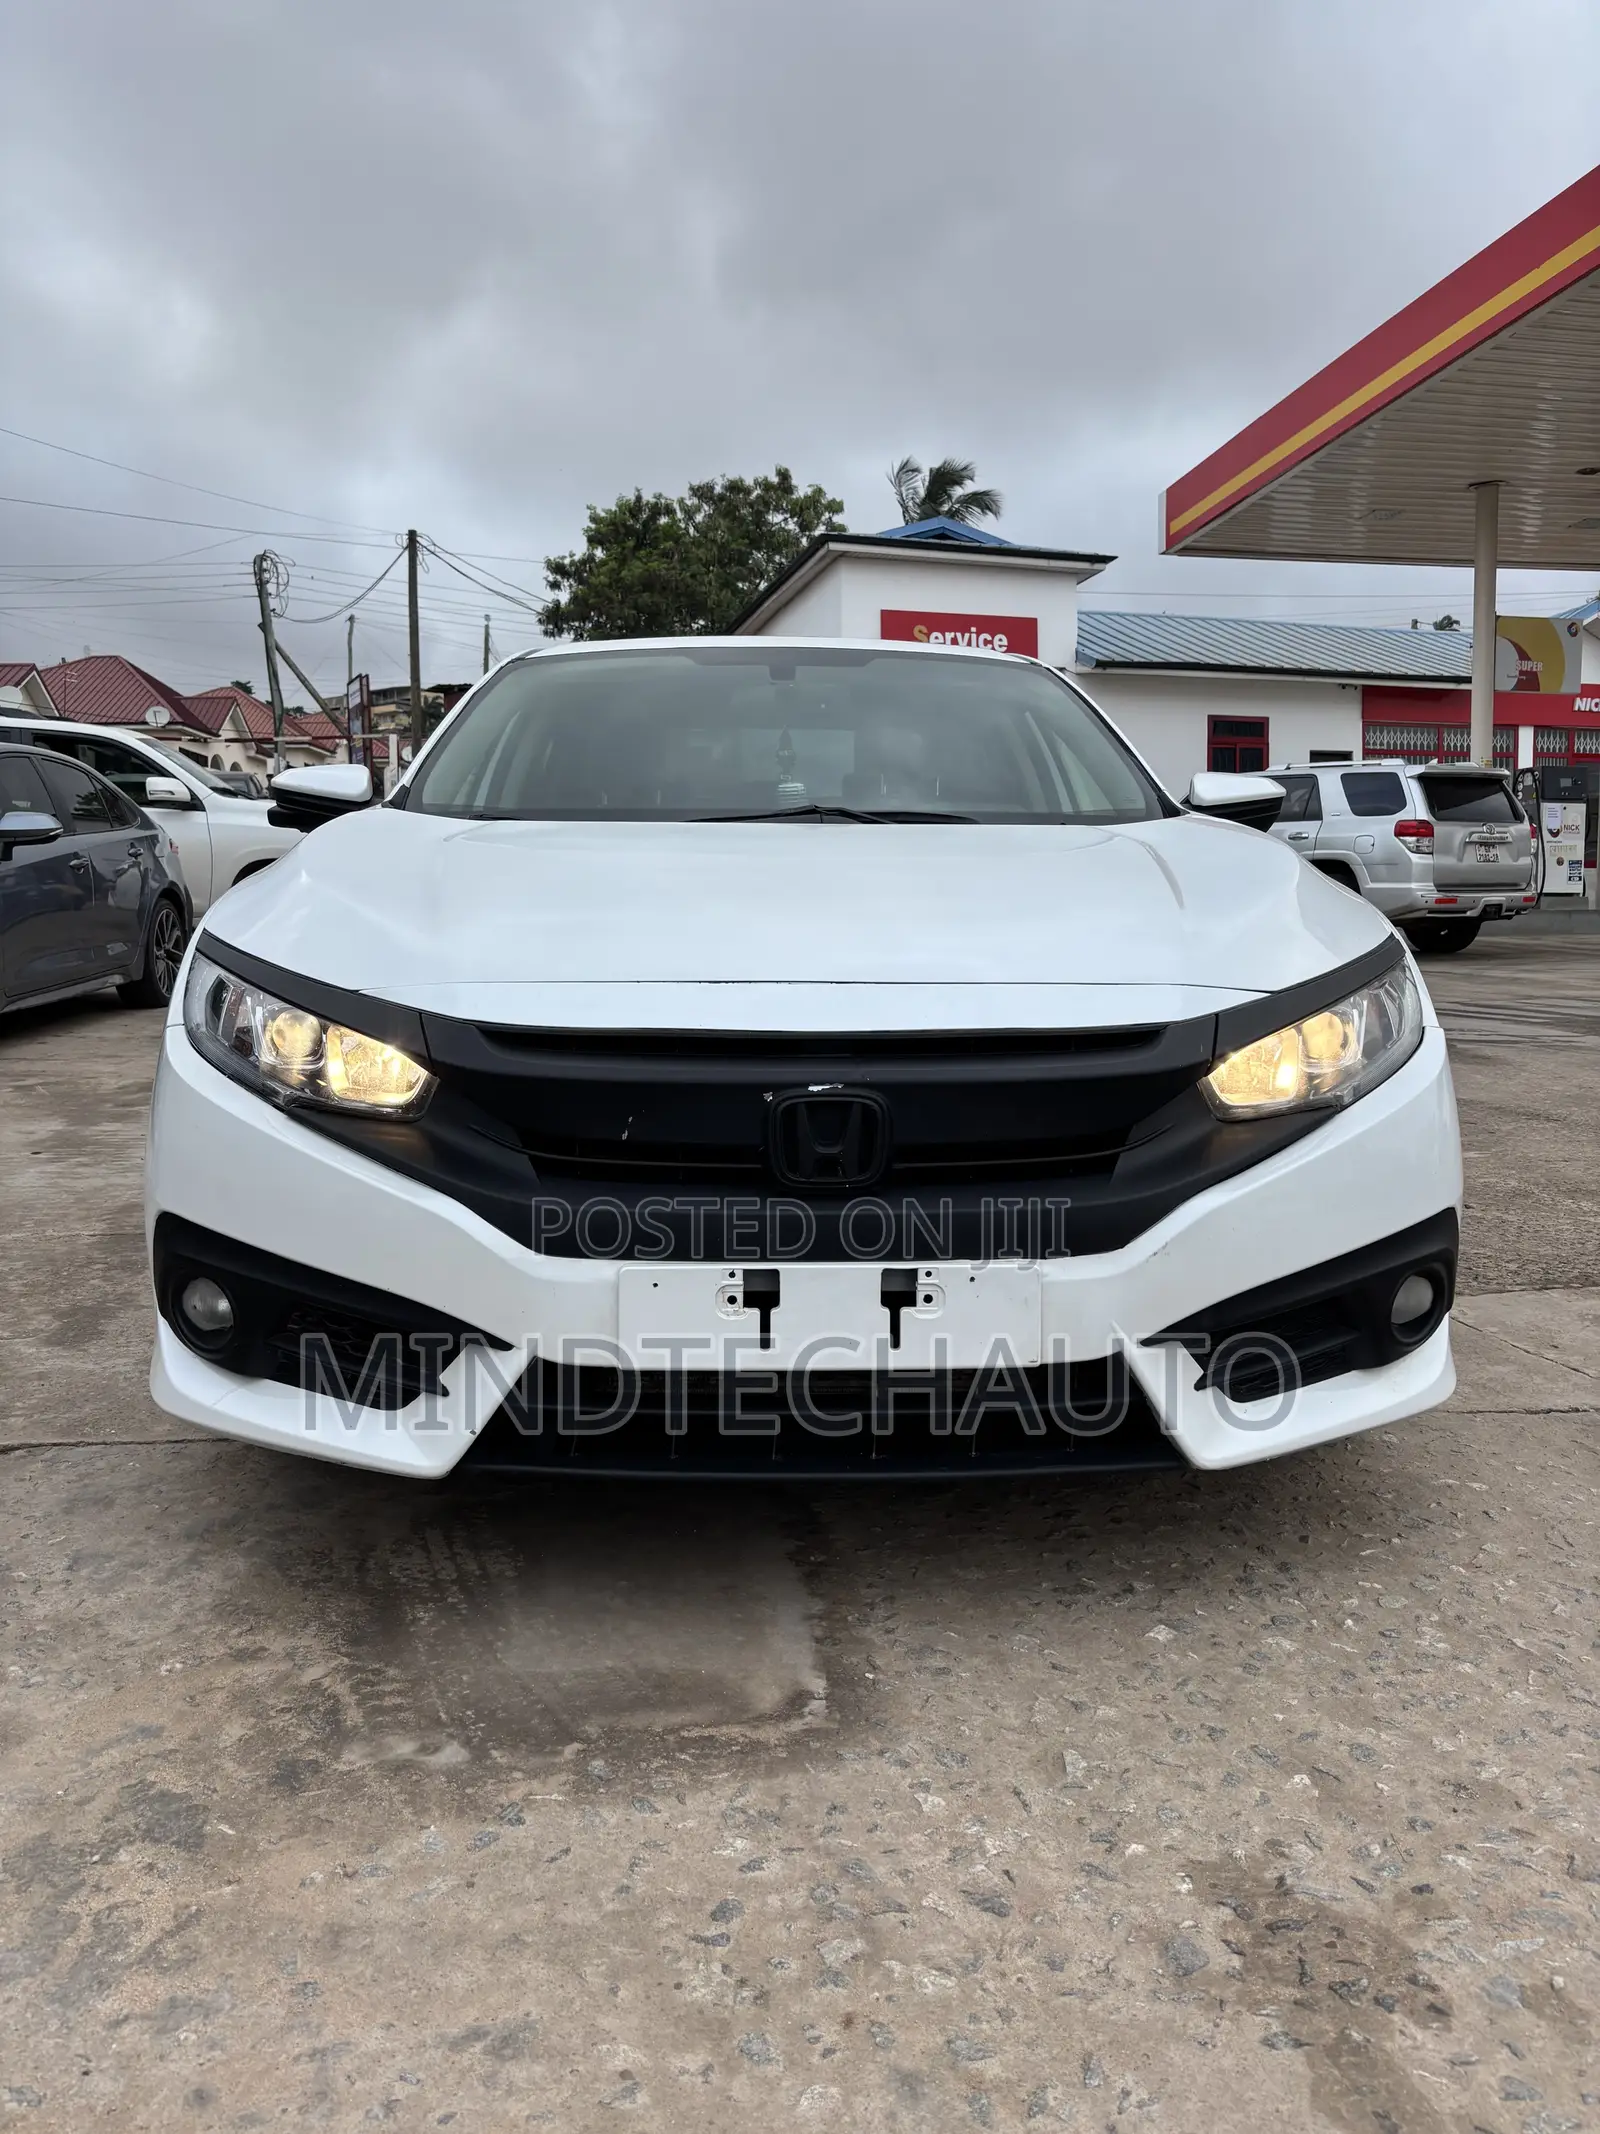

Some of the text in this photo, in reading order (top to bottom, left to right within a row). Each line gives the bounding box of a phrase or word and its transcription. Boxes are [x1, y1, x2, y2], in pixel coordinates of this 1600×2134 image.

[913, 625, 1008, 652] Service
[1516, 660, 1543, 672] SUPER
[1563, 824, 1580, 832] NICK
